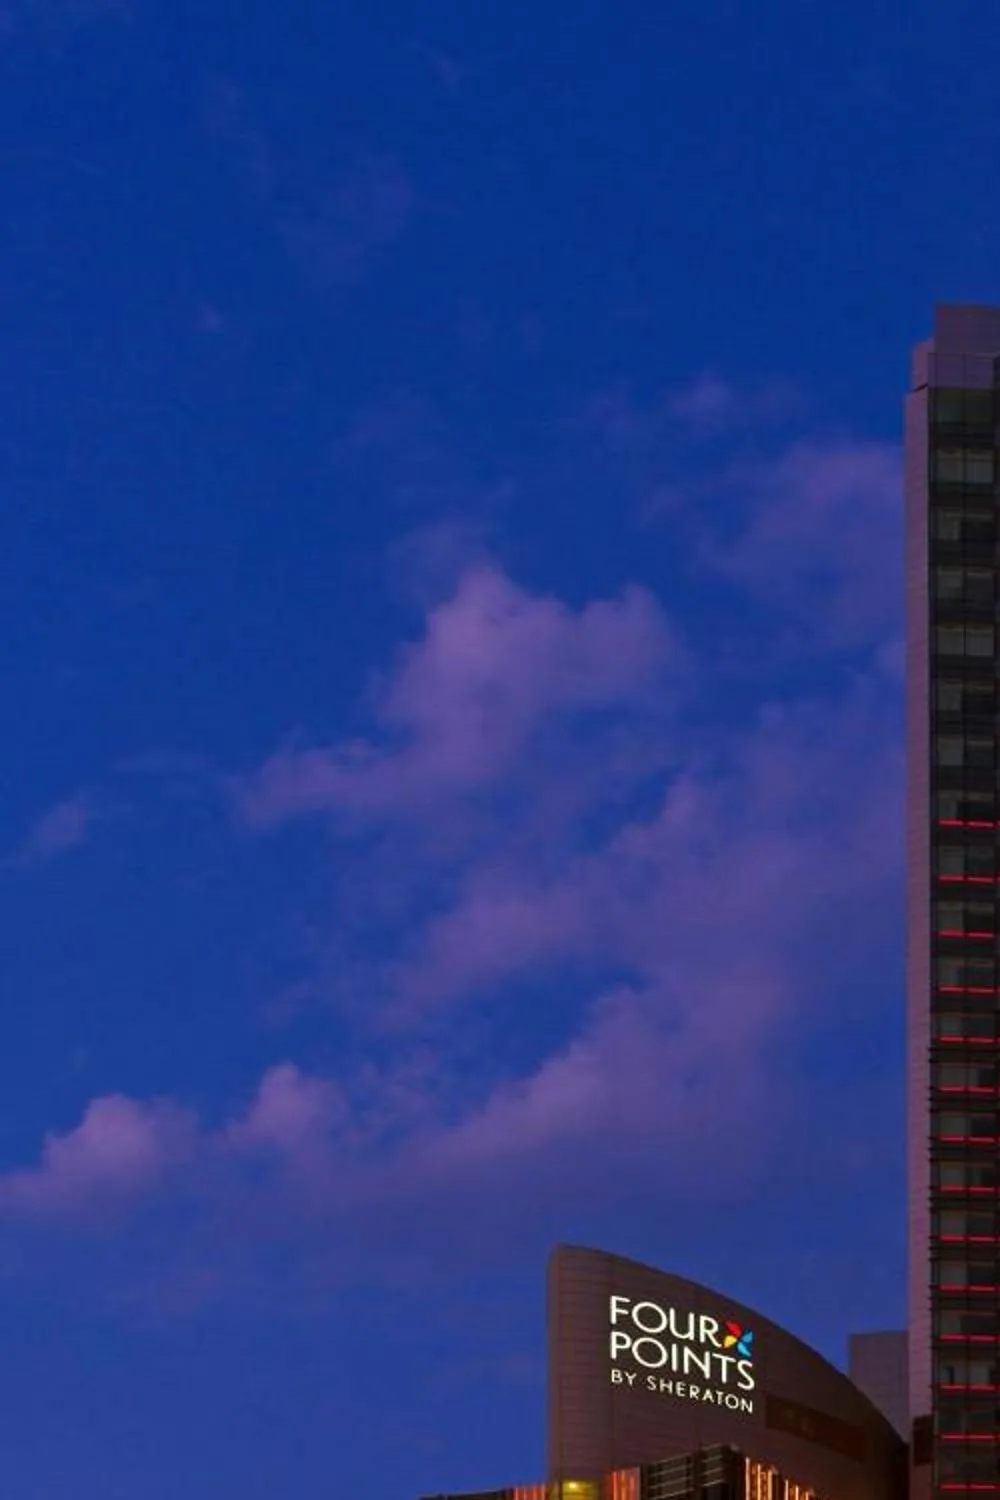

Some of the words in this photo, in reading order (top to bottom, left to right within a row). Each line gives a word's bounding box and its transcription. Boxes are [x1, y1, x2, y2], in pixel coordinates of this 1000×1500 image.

[609, 1295, 722, 1348] FOUR
[610, 1331, 755, 1390] POINTS
[610, 1369, 638, 1386] BY
[647, 1375, 754, 1414] SHERATON
